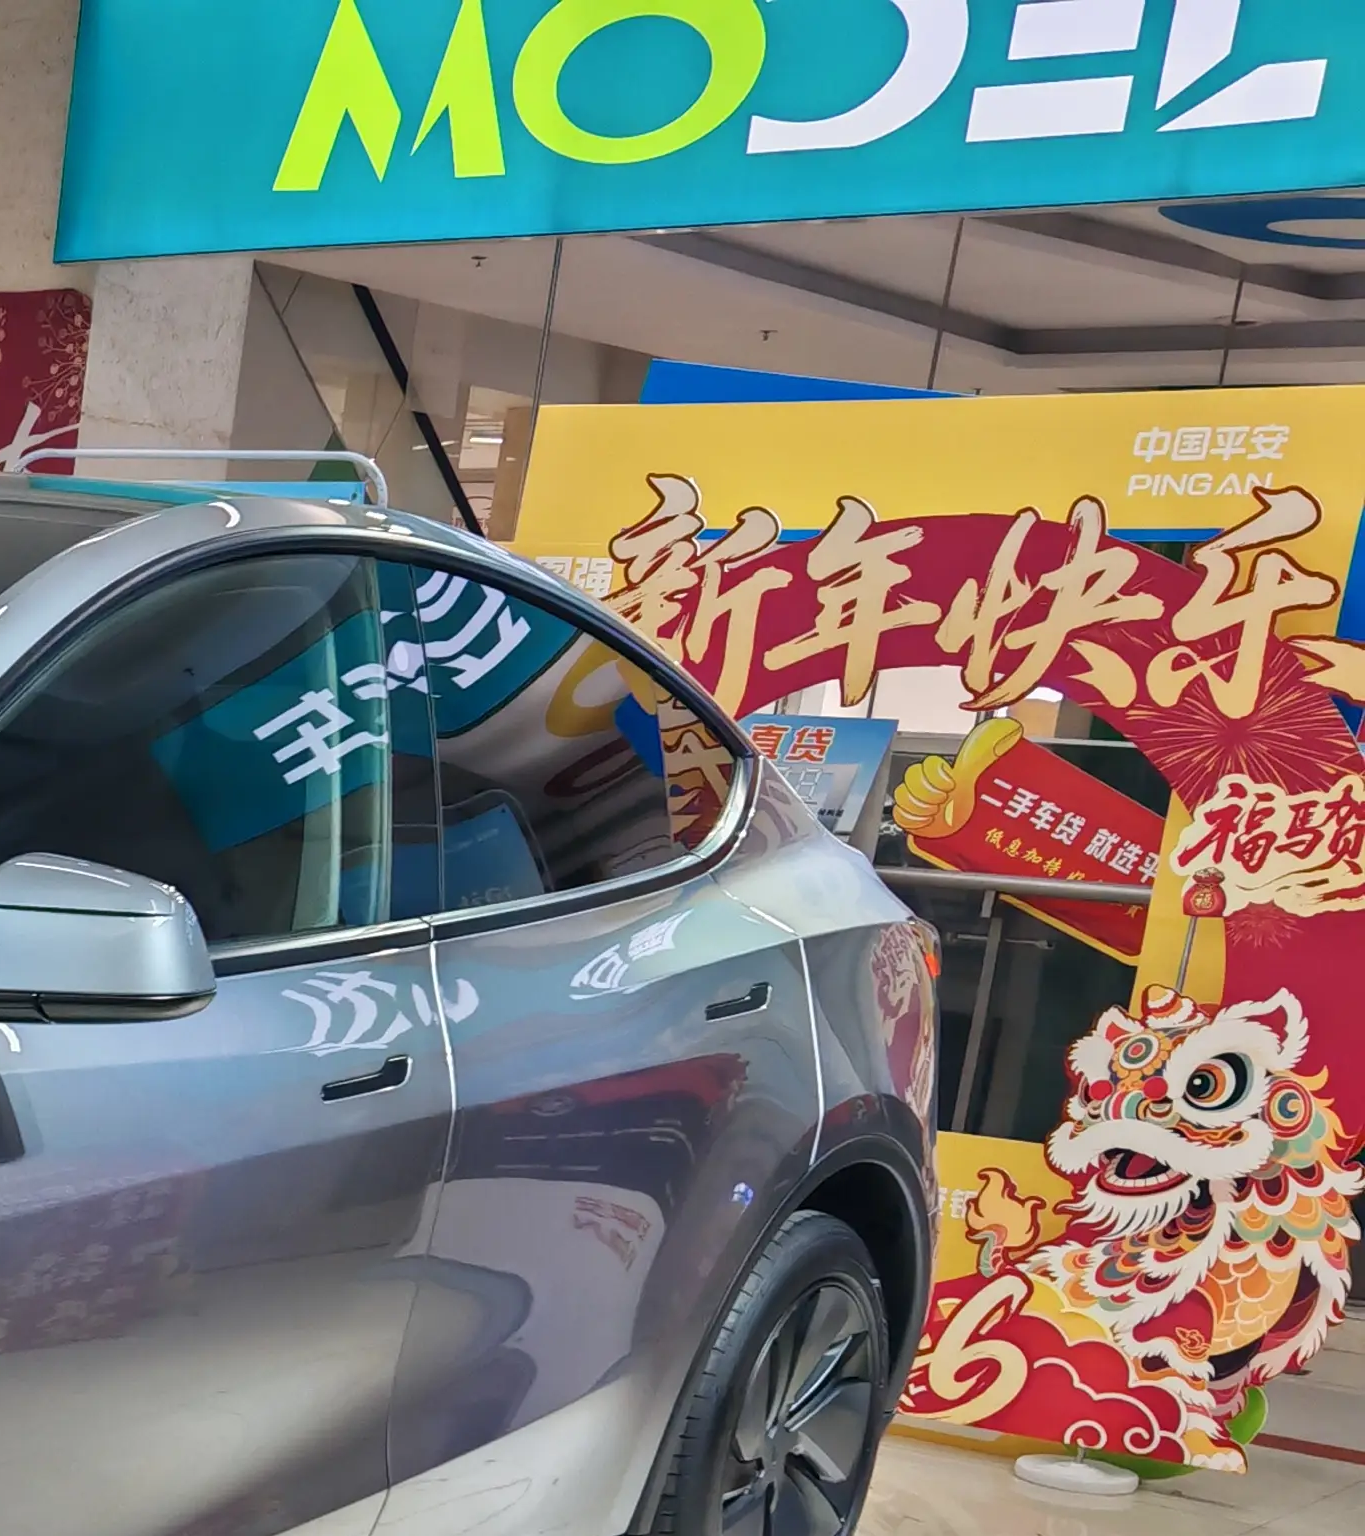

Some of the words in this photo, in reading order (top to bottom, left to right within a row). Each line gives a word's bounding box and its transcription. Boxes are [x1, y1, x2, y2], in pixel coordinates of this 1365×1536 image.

[1133, 425, 1290, 463] 中国平安
[609, 472, 1365, 715] 新年快乐
[980, 777, 1087, 846] 二手车贷
